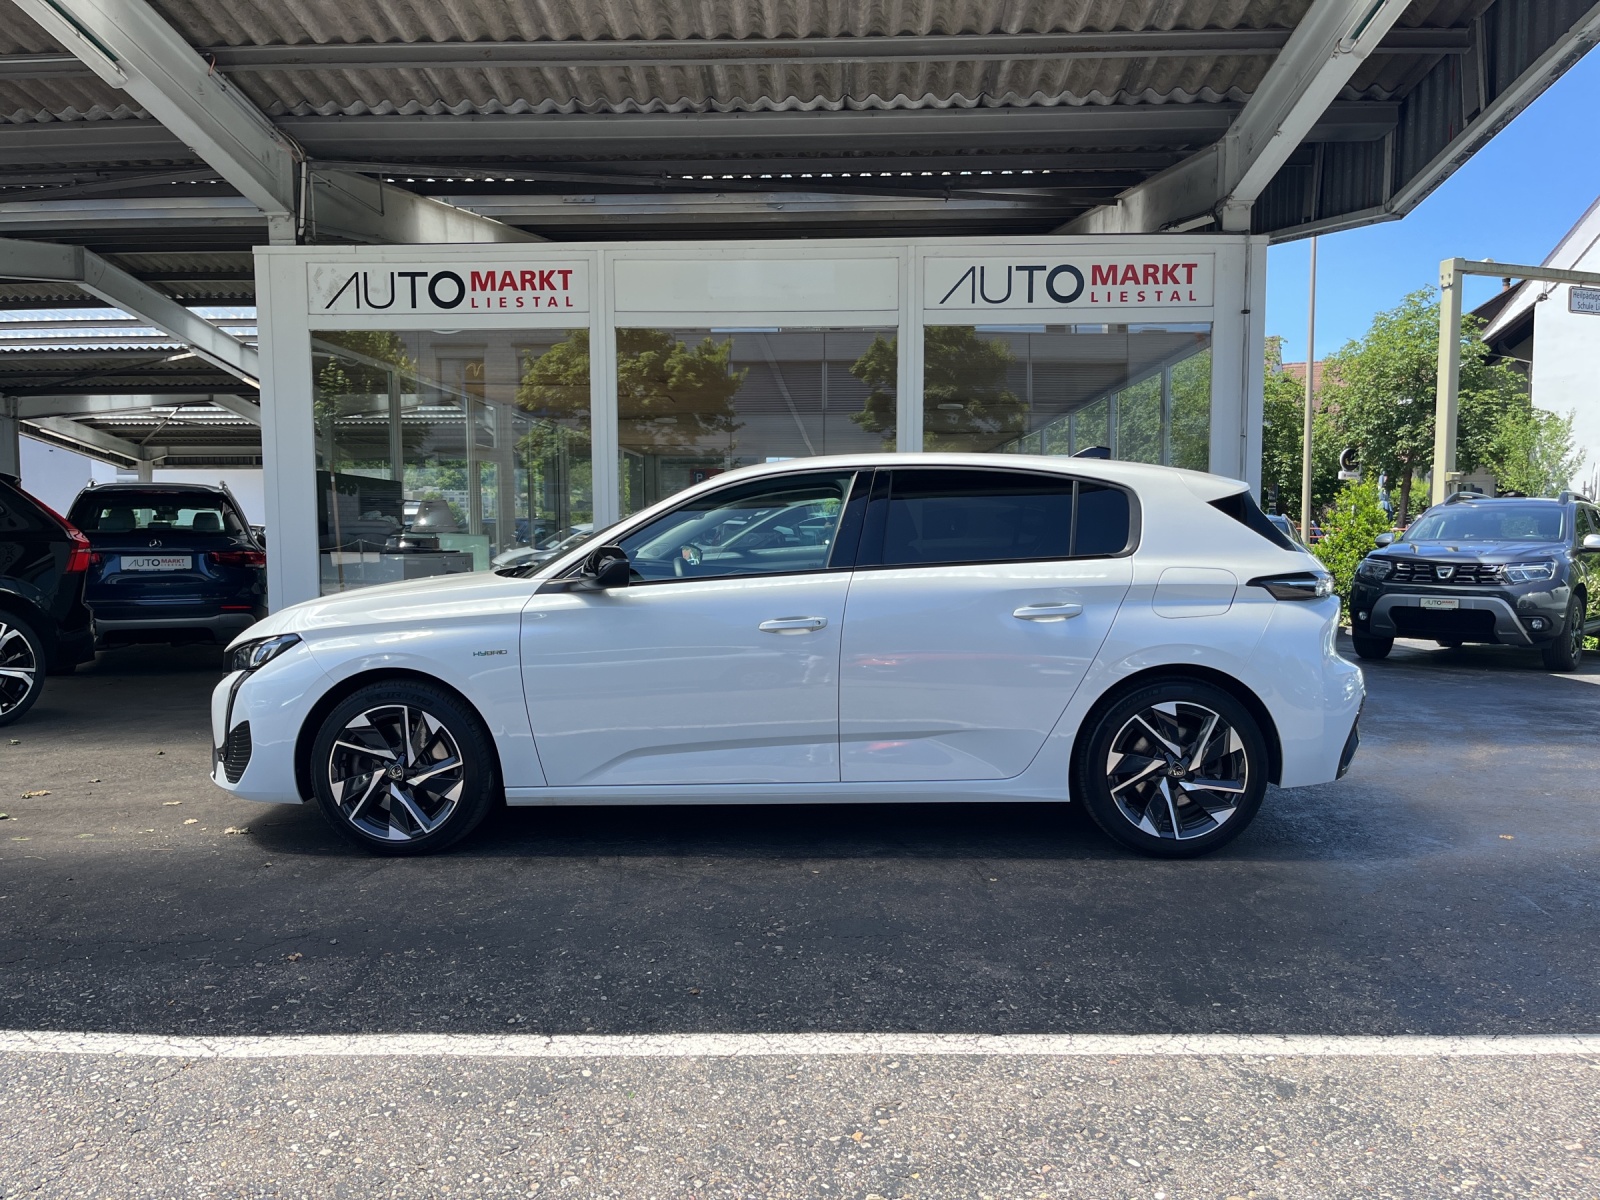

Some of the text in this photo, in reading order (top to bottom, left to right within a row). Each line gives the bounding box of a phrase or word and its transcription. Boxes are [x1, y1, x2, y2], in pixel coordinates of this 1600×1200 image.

[325, 270, 573, 309] AUTO MARKT
[939, 263, 1198, 304] AUTO MARKT
[471, 296, 573, 308] LIESTAL
[1090, 290, 1197, 303] LIESTAL
[1577, 301, 1593, 311] Schule
[696, 473, 703, 482] P
[129, 559, 160, 567] AUTO
